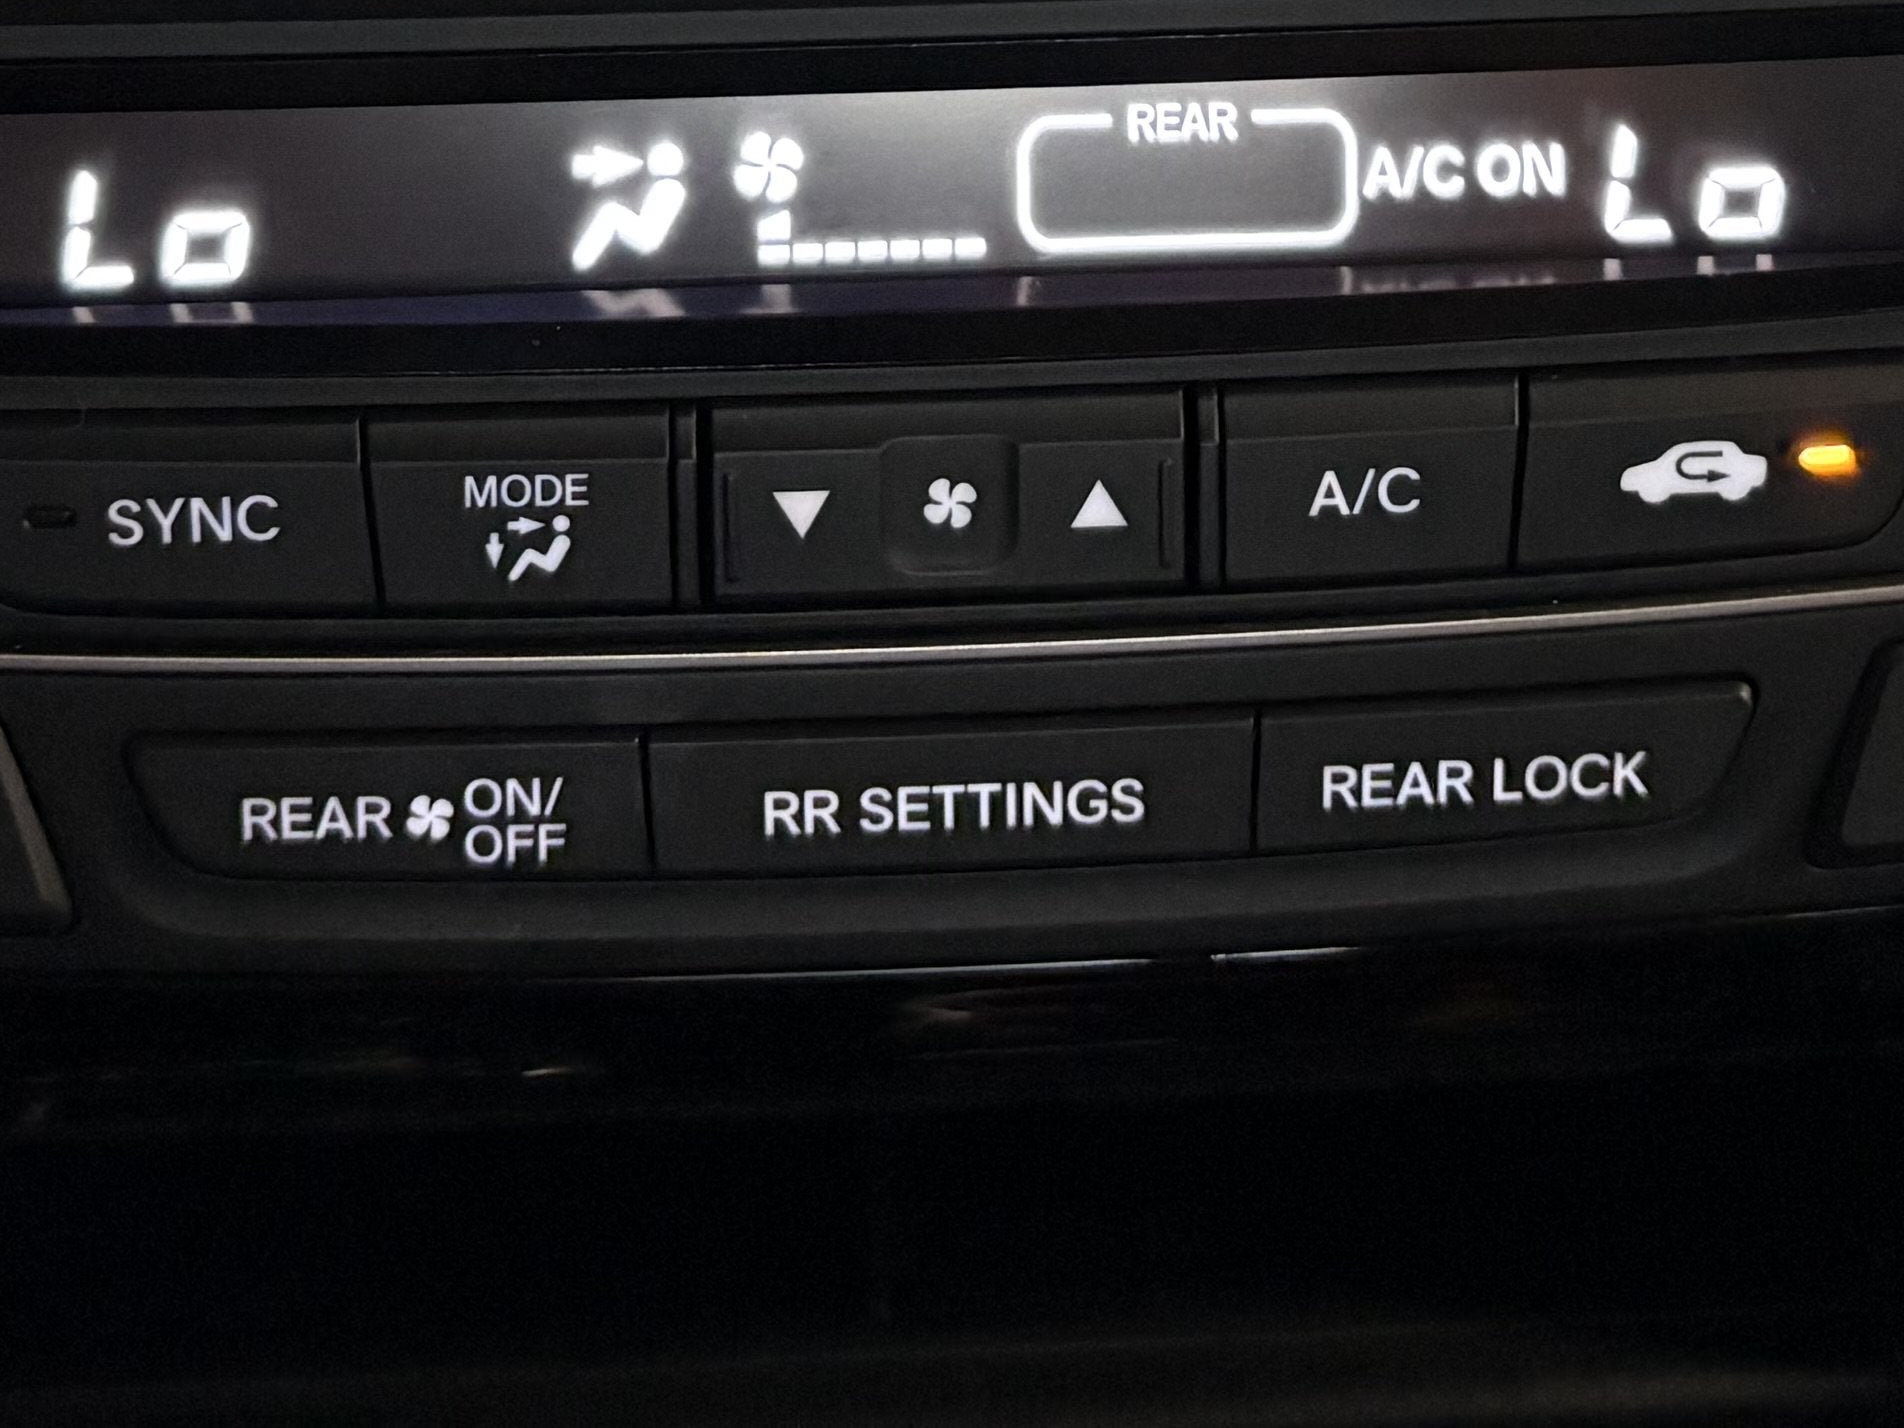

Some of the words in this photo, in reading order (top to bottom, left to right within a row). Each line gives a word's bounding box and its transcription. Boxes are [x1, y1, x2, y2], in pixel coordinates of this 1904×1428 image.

[1124, 98, 1241, 146] REAR
[1360, 141, 1467, 202] A/C
[1473, 138, 1568, 200] ON
[1601, 121, 1788, 245] Lo
[60, 168, 253, 292] Lo
[106, 492, 282, 548] SYNC
[462, 471, 591, 510] MODE
[1307, 465, 1423, 519] A/C
[240, 794, 395, 843] REAR
[461, 775, 565, 820] ON/
[762, 787, 843, 838] RR
[857, 776, 1147, 835] SETTINGS
[1320, 758, 1475, 811] REAR
[1491, 749, 1650, 804] LOCK
[462, 821, 568, 866] OFF
